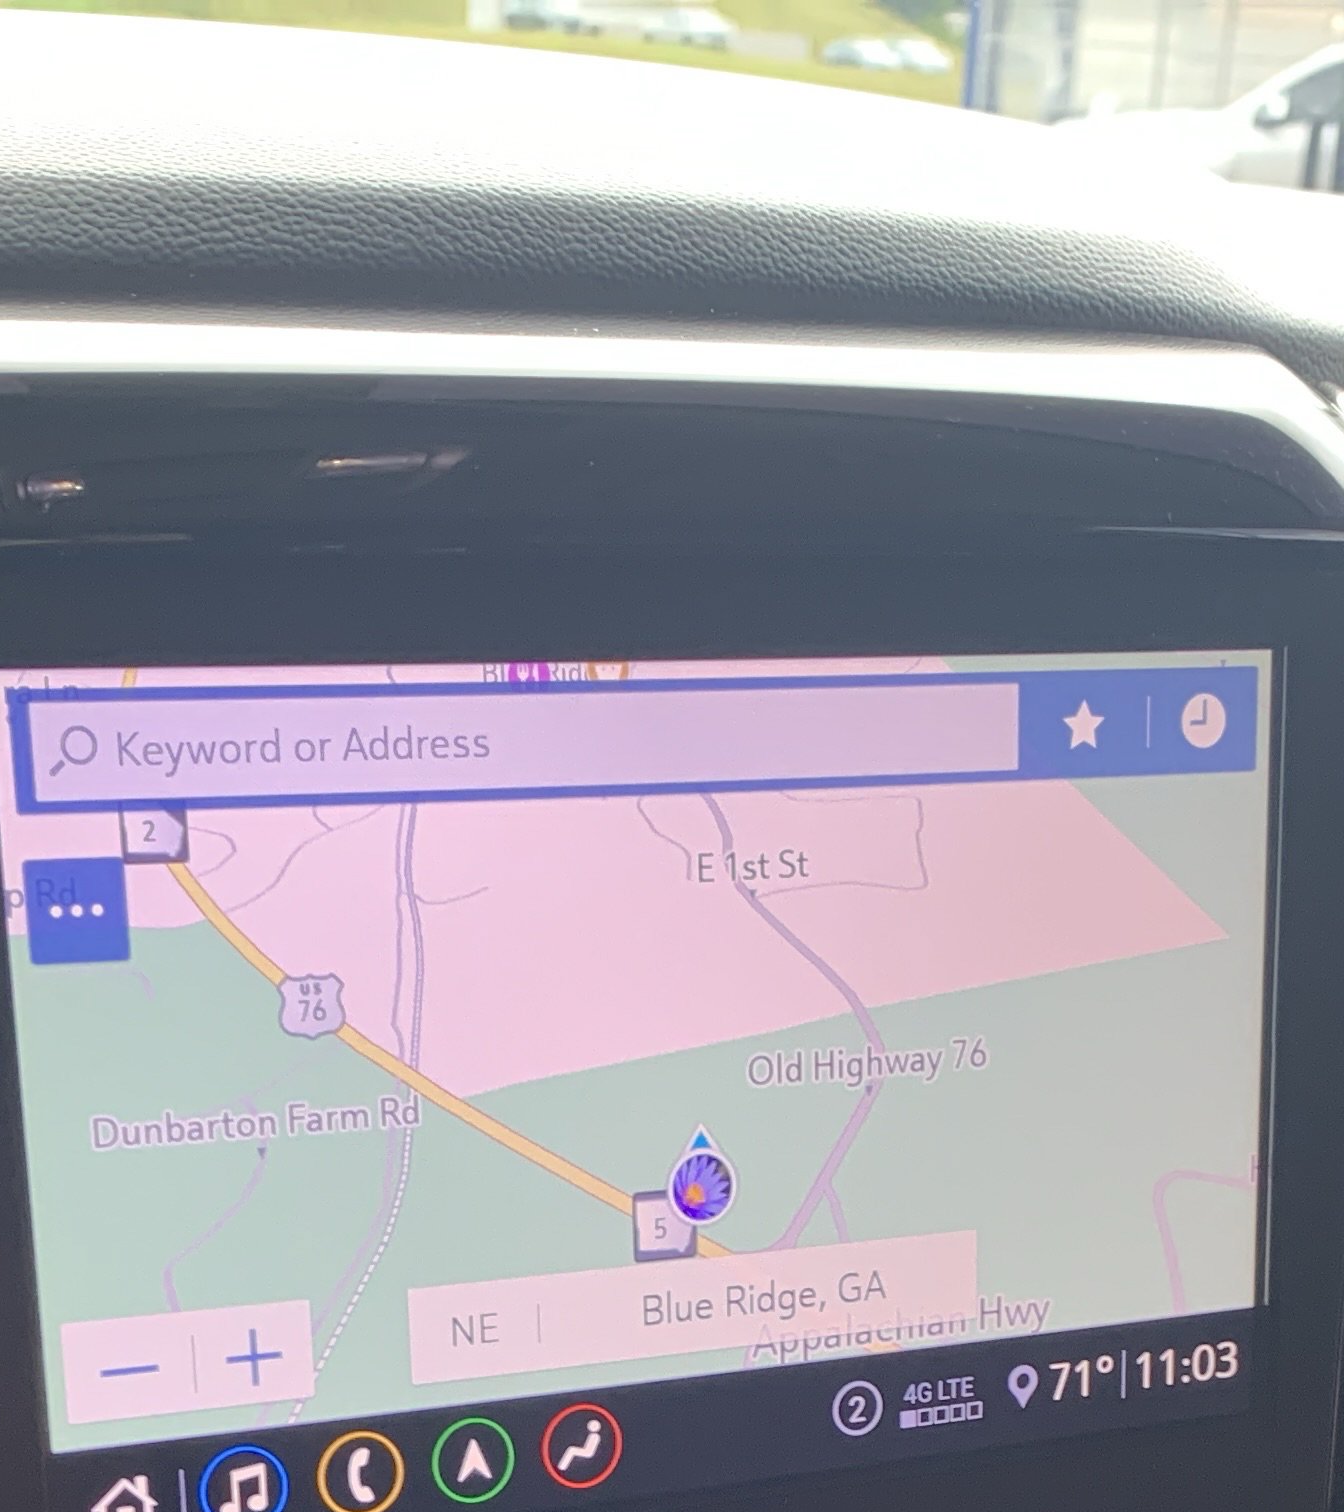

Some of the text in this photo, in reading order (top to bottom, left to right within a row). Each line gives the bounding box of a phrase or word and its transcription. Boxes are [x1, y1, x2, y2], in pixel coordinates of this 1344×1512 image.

[116, 726, 491, 777] Keyword or Address
[142, 820, 156, 843] 2
[697, 849, 810, 882] E 1st St
[298, 998, 327, 1022] 76
[748, 1038, 987, 1087] Old Highway 76
[92, 1095, 421, 1149] Dunbarton Farm Rd
[654, 1217, 668, 1240] 5
[451, 1270, 888, 1346] NE Blue Ridge, GA
[752, 1296, 1051, 1363] Appalachian Hwy
[849, 1341, 1240, 1423] 2 4G LTE 71° 11:03
